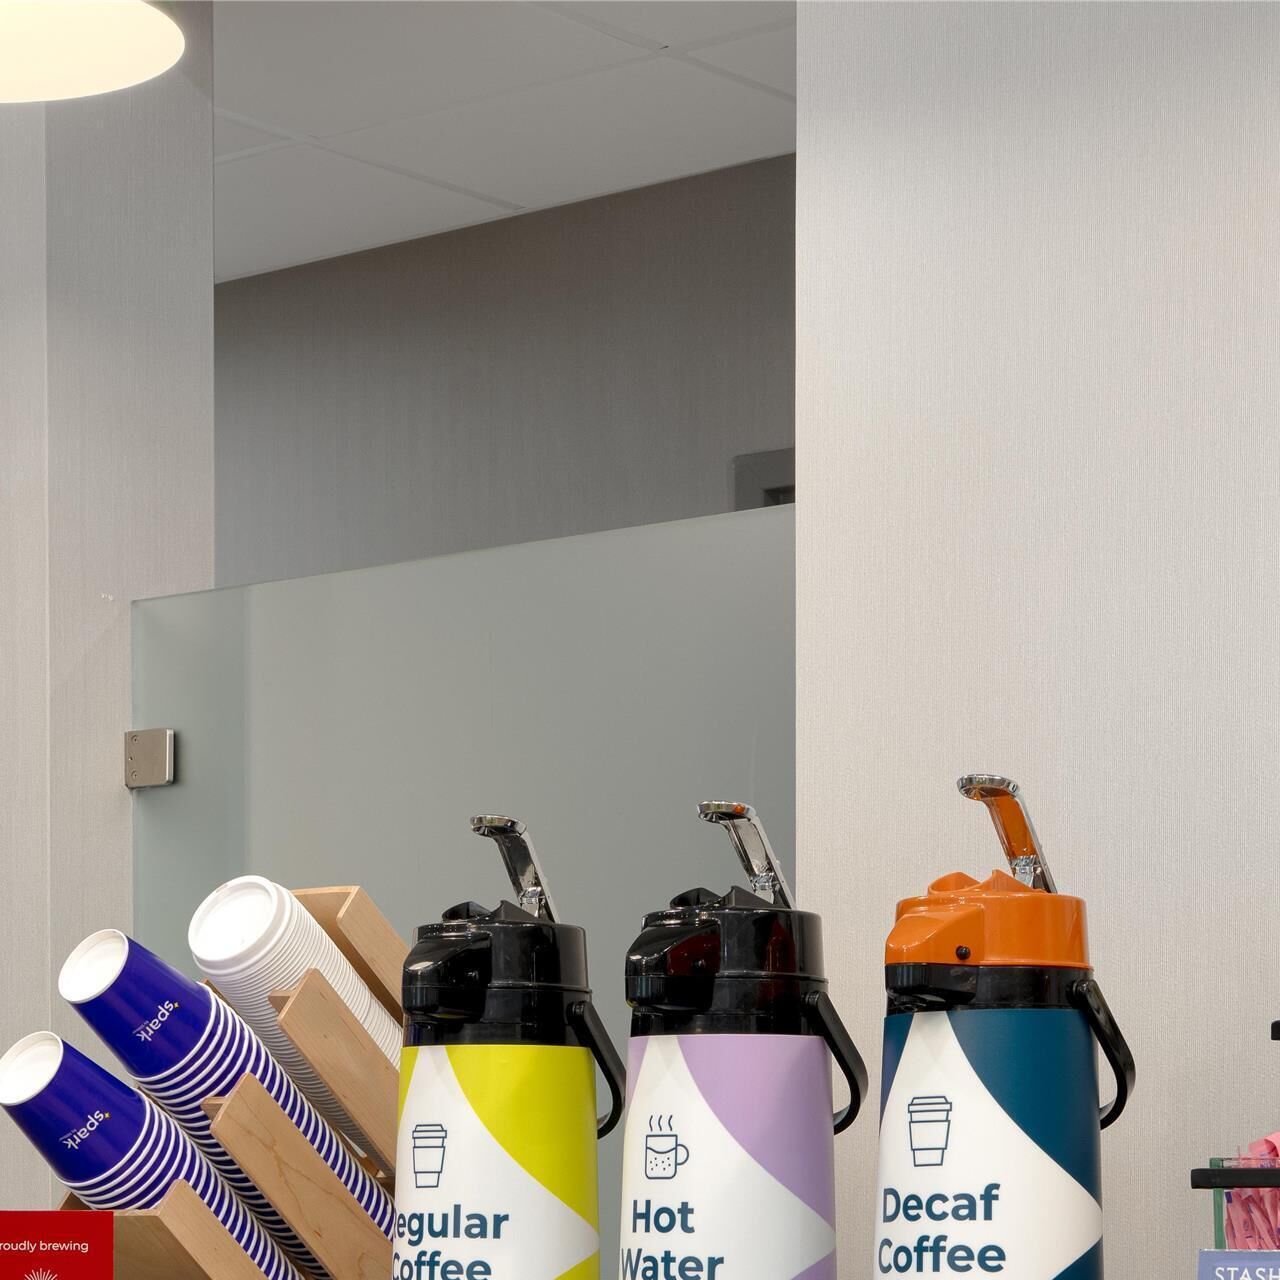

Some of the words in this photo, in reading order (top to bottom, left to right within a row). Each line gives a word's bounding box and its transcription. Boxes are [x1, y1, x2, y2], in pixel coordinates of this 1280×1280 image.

[135, 1000, 174, 1042] spark
[62, 1110, 105, 1150] spark
[632, 1199, 695, 1234] Hot
[882, 1183, 1001, 1223] Decaf
[393, 1204, 509, 1247] egular
[40, 1240, 89, 1253] brewing
[878, 1235, 1007, 1274] Coffee
